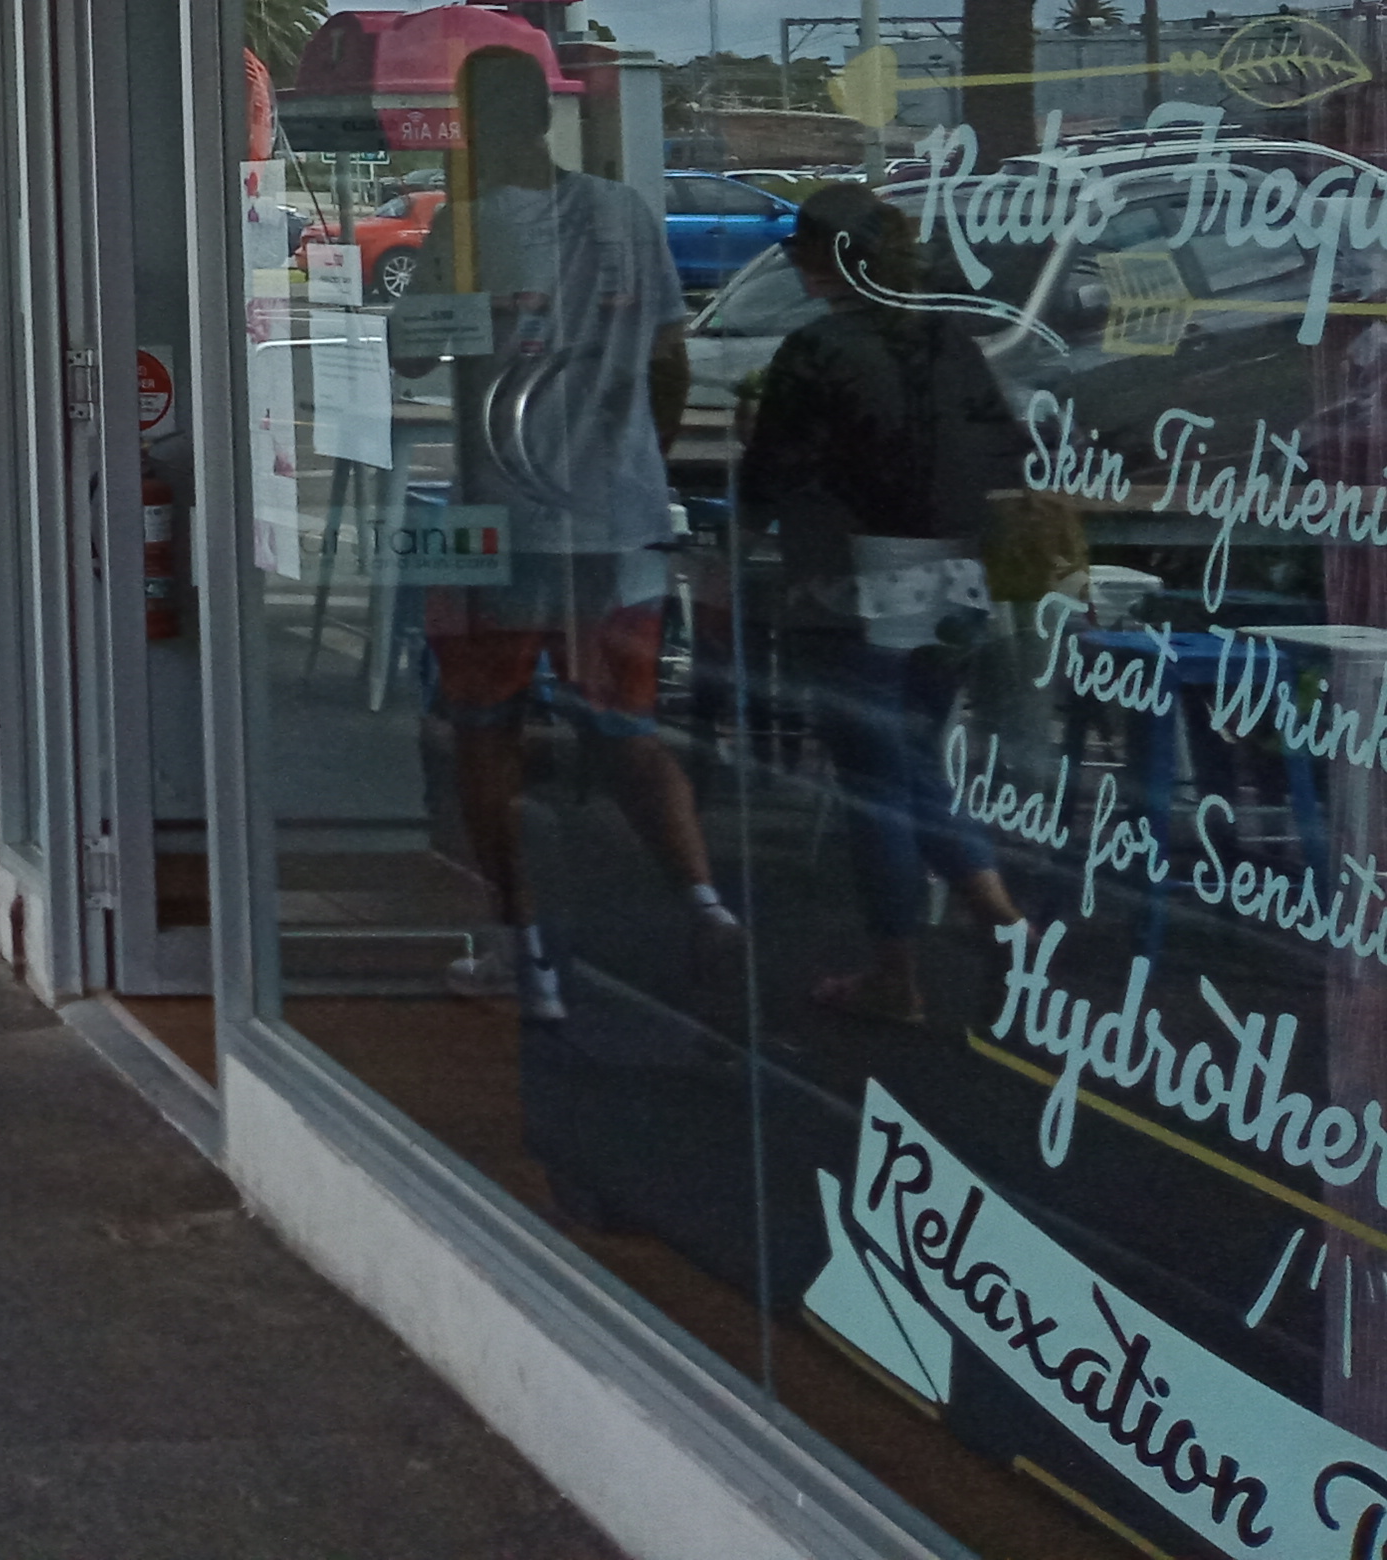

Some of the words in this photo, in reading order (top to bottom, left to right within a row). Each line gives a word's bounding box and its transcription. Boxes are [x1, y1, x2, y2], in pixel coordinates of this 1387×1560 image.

[914, 109, 1126, 290] Radio
[1026, 391, 1131, 502] Skin
[1034, 591, 1178, 717] Treat
[944, 725, 1068, 849] Ideal
[1081, 774, 1168, 918] for
[869, 1115, 1275, 1548] Relaxation
